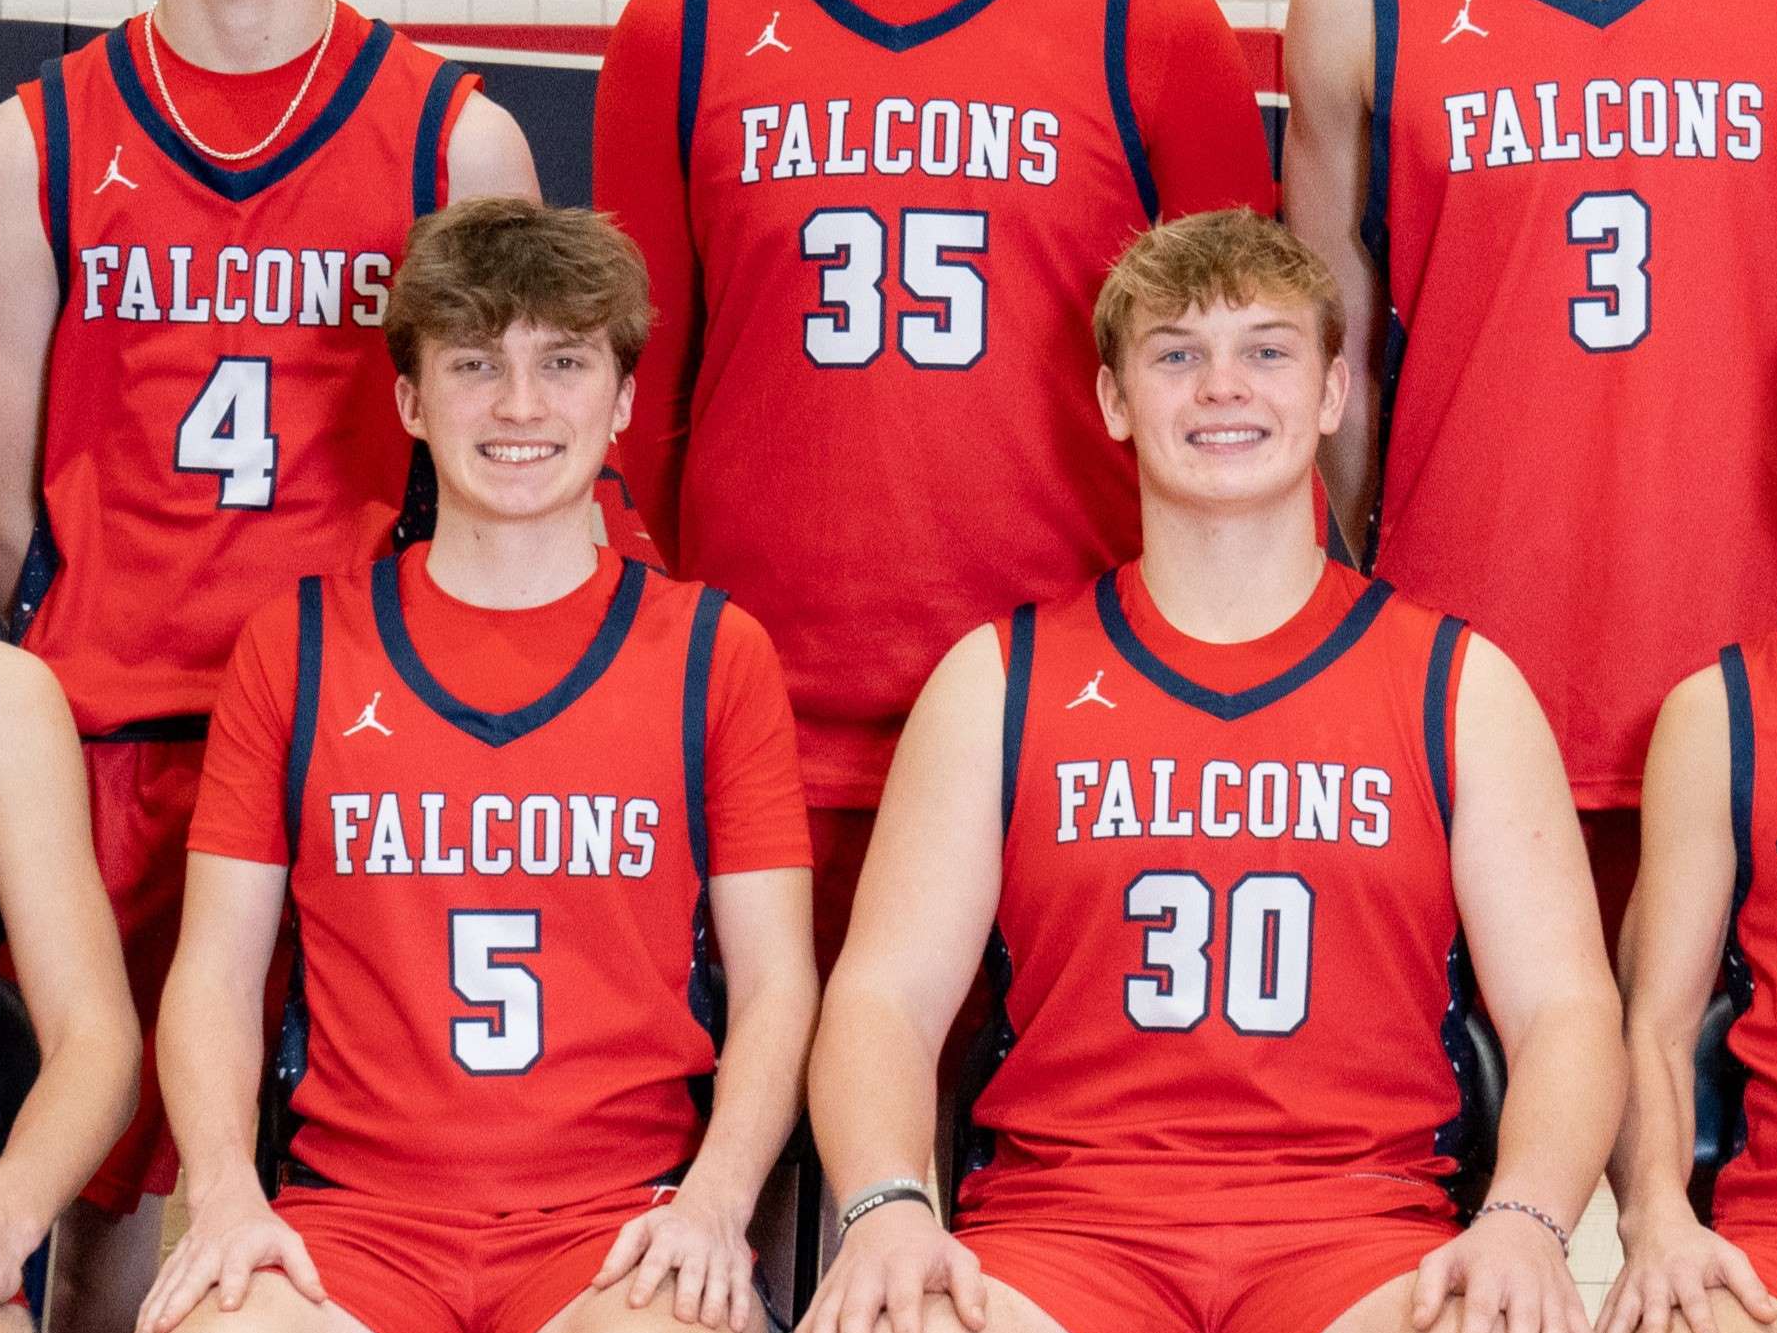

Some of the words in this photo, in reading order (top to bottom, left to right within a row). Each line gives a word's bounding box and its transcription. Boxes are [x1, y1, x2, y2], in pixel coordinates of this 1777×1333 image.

[739, 96, 1061, 186] FALCONS
[1443, 77, 1764, 173] FALCONS
[80, 243, 391, 328] FALCONS
[799, 206, 990, 371] 35
[1566, 188, 1653, 354] 3
[173, 356, 280, 512] 4
[329, 791, 661, 879] FALCONS
[1054, 758, 1394, 850] FALCONS
[447, 908, 545, 1076] 5
[1124, 869, 1317, 1038] 30
[847, 1194, 885, 1221] BACK
